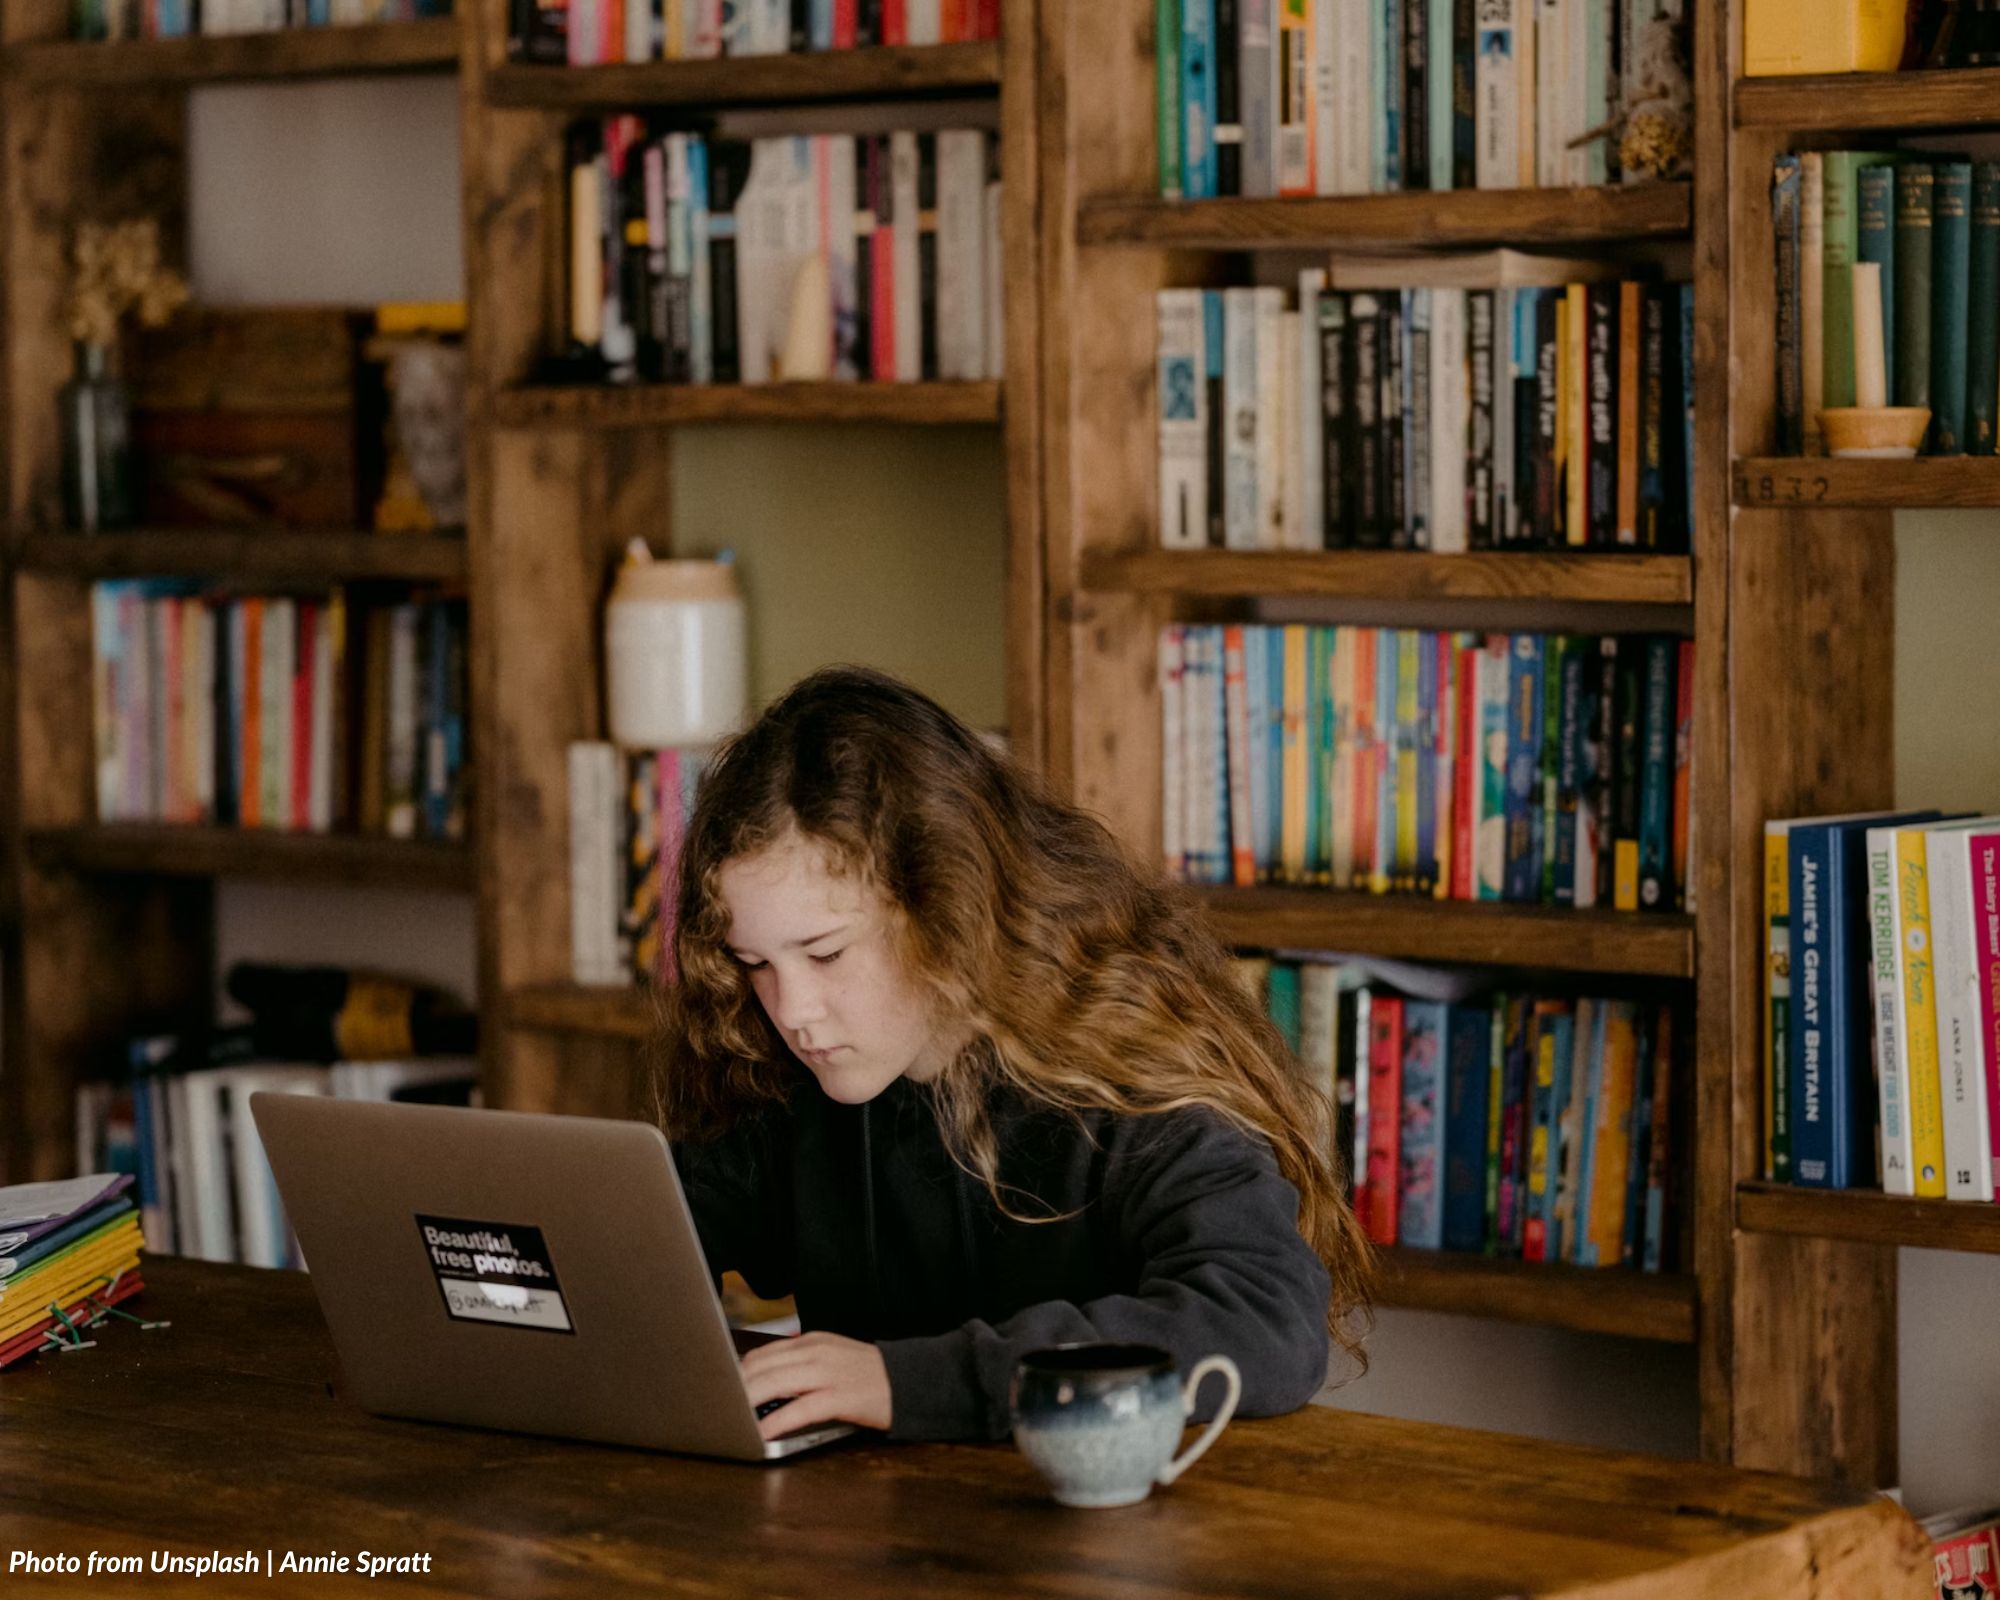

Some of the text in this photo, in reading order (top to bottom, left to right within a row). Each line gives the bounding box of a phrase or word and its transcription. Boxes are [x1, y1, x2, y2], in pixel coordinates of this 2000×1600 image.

[1871, 850, 1889, 888] TOM
[1873, 893, 1896, 982] KERRIDGE
[1801, 855, 1820, 1122] JAMIE'S GREAT BRITAIN
[424, 1226, 519, 1256] Beautiful,
[431, 1246, 550, 1278] free photos.
